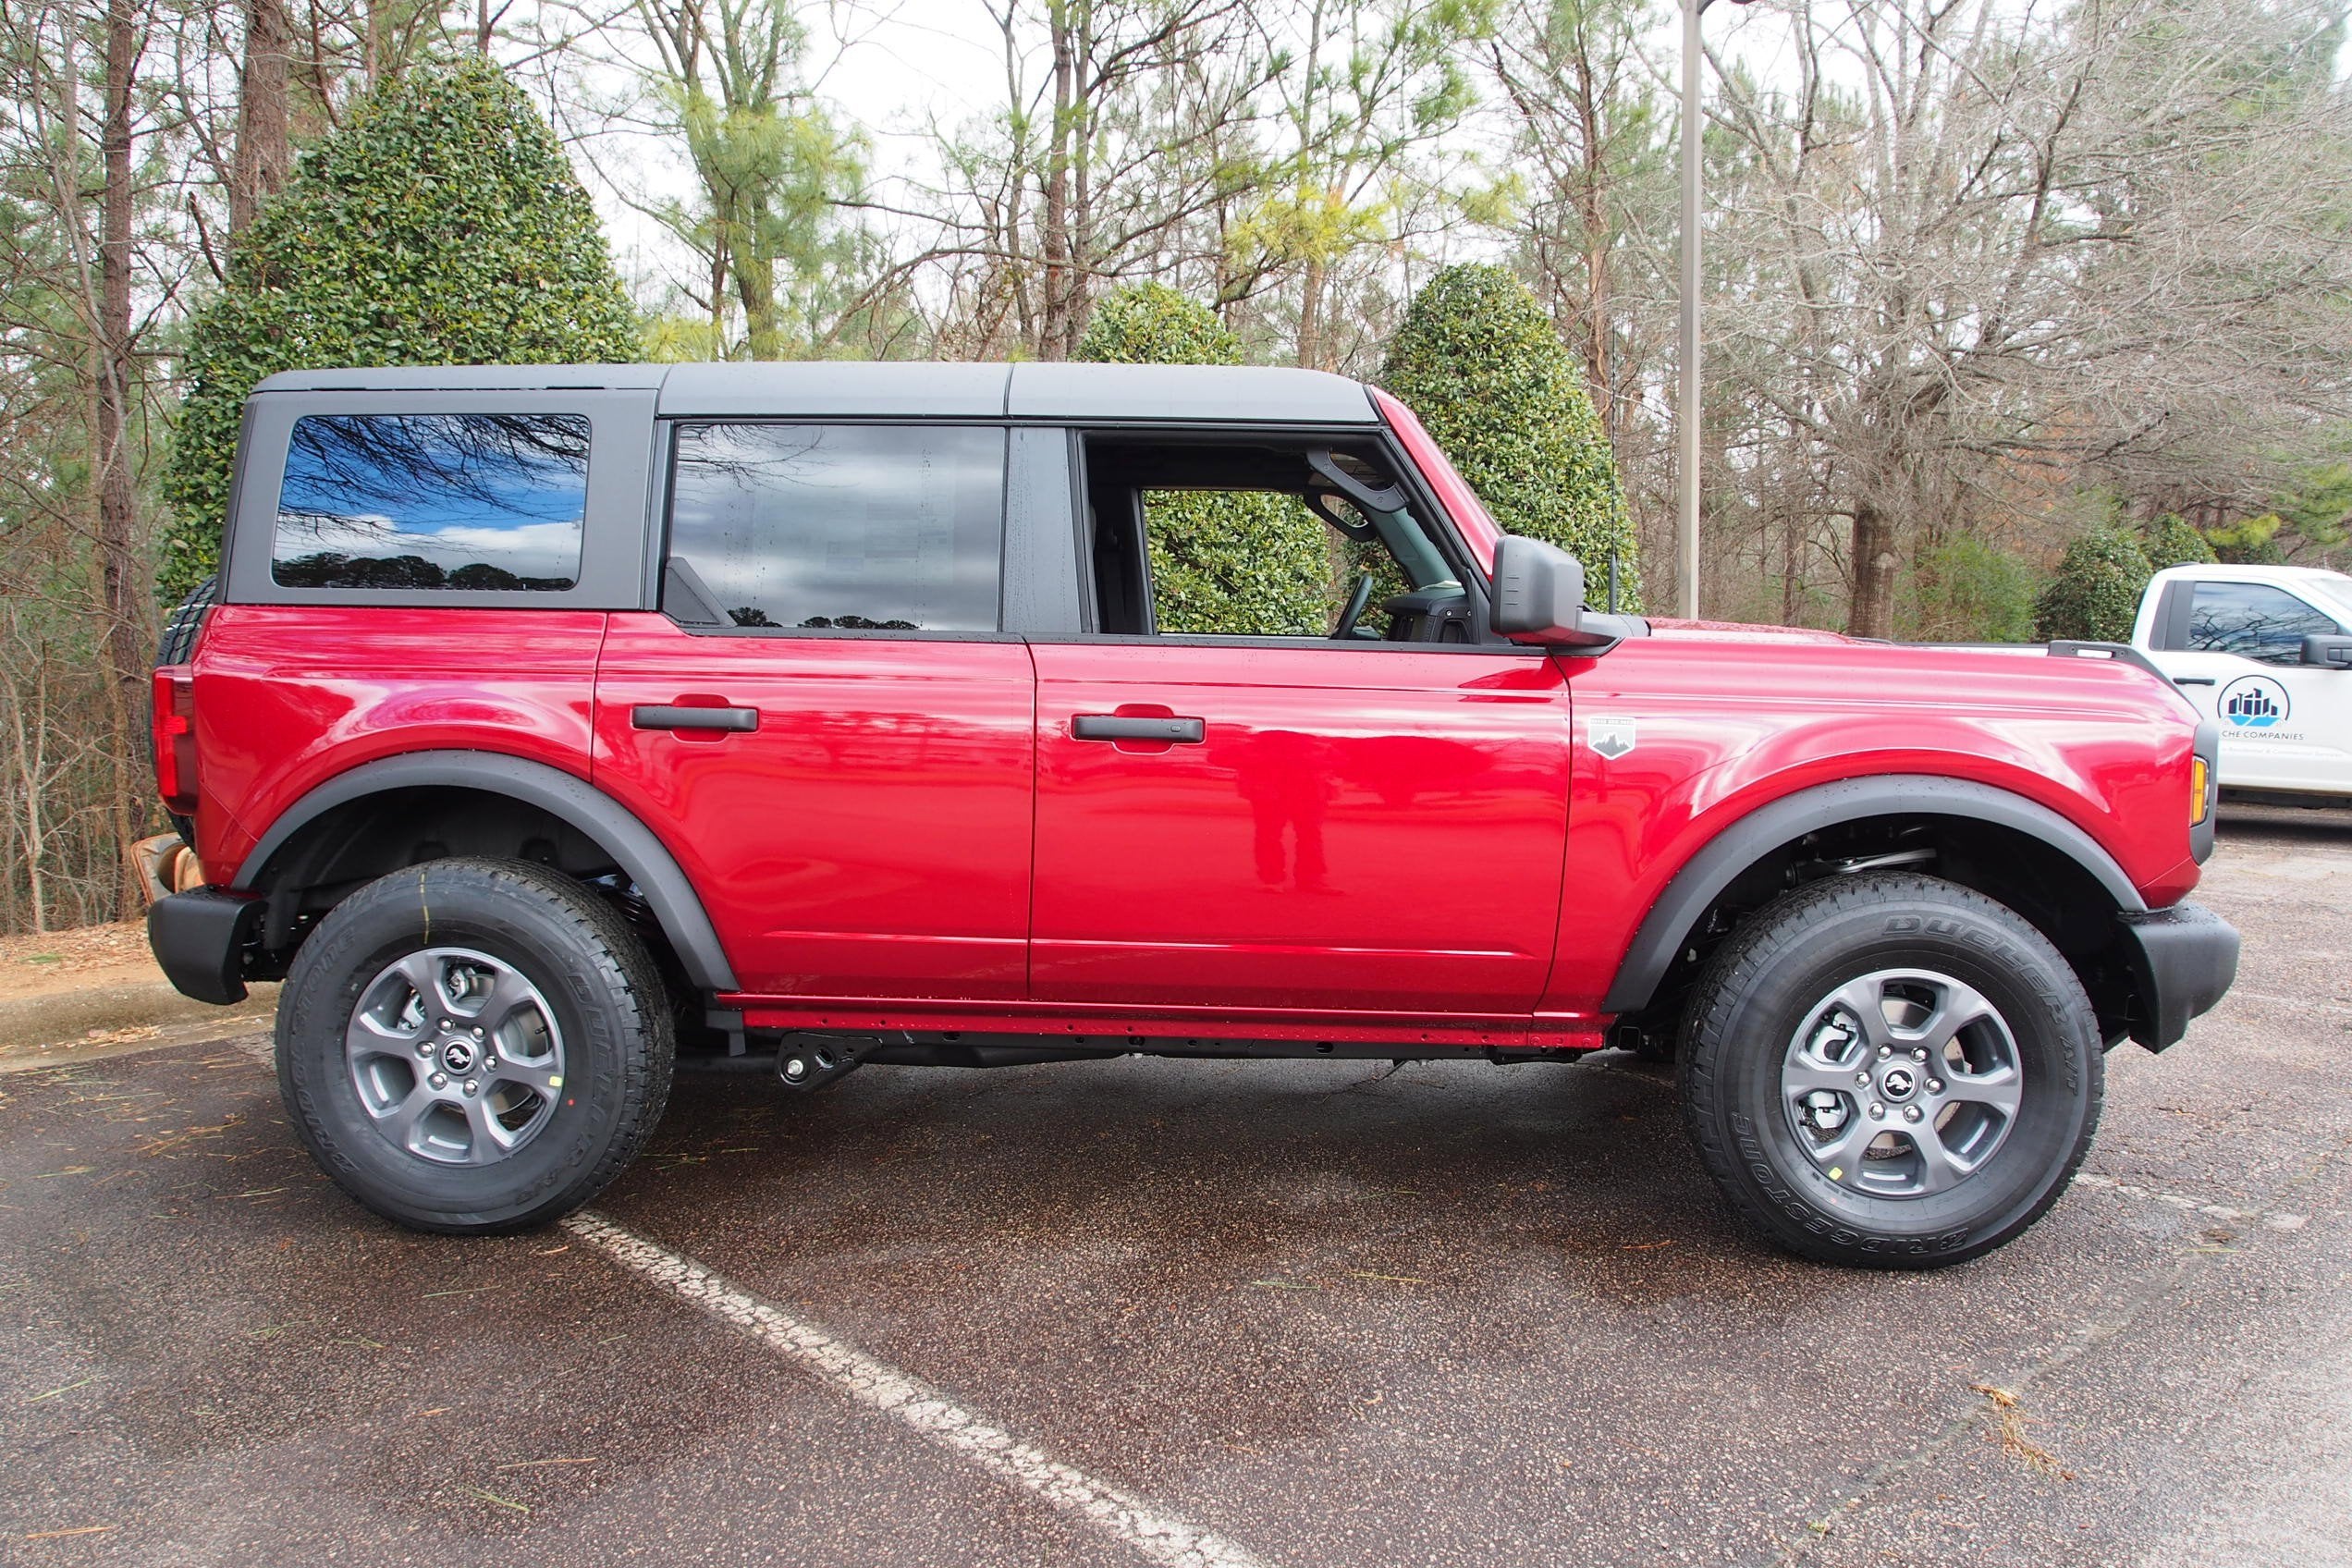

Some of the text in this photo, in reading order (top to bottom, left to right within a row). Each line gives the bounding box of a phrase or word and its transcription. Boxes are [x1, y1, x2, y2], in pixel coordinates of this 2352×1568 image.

[2242, 730, 2305, 741] COMPANIES
[1881, 914, 2073, 1027] DUELER
[1731, 1109, 1970, 1256] BRIDGESTONE
